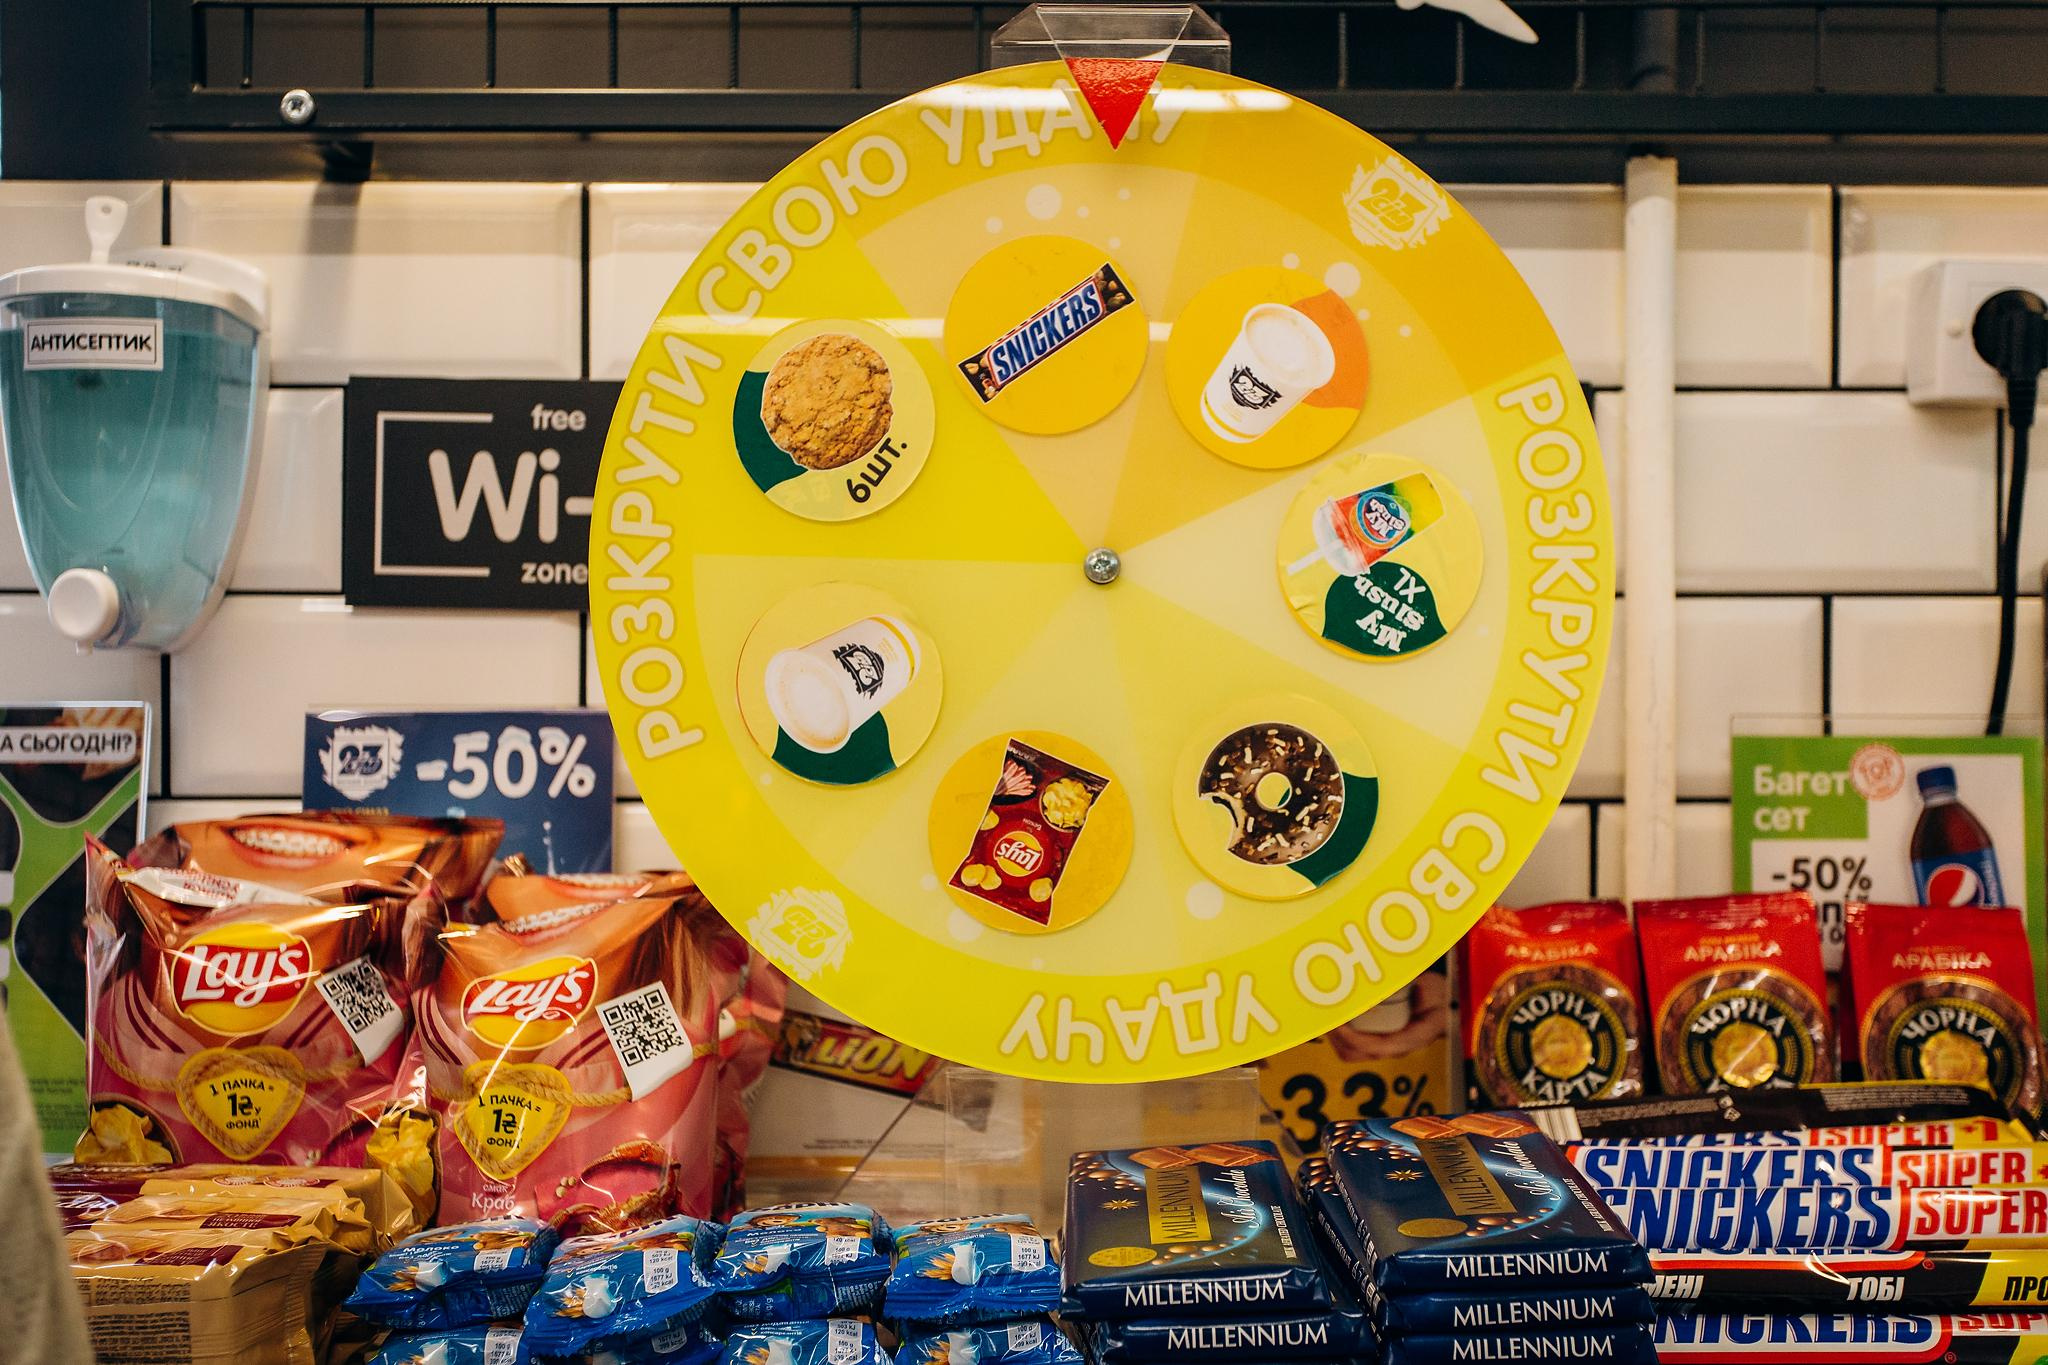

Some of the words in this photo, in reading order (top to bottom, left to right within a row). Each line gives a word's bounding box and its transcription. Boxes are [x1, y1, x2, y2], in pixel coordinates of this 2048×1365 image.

[30, 332, 153, 354] АНТИСЕПТИК
[992, 285, 1102, 383] SNICKERS
[532, 404, 586, 431] free
[608, 334, 722, 759] РОЗКРУТИ
[698, 136, 908, 325] СВОЮ
[920, 80, 1195, 168] УДАУ
[521, 562, 587, 584] zone
[1394, 568, 1426, 604] XL
[1481, 373, 1597, 803] РОЗКРУТИ
[1356, 610, 1407, 653] My
[20, 732, 133, 755] СЬОГОДНІ?
[416, 726, 596, 799] -50%
[1753, 764, 1849, 797] Багет
[1753, 807, 1810, 832] сет
[1772, 857, 1872, 891] -50%
[1293, 812, 1507, 1007] СВОЮ
[182, 943, 303, 1008] Lay's
[467, 967, 591, 1023] Lay's
[1512, 990, 1600, 1032] ЧОРНА
[1001, 972, 1280, 1064] УДАЧУ
[1691, 995, 1788, 1037] ЧОРНА
[1902, 1004, 1998, 1049] ЧОРНА
[222, 1078, 266, 1091] ПАЧКА
[1522, 1066, 1609, 1102] КАРТА
[490, 1094, 532, 1111] ПАЧКА
[1584, 1147, 1877, 1188] SNICKERS
[1897, 1152, 2026, 1187] SUPER
[471, 1192, 516, 1214] Краб
[1156, 1166, 1199, 1240] MILLENNIUM
[1597, 1187, 1893, 1249] SNICKERS
[1913, 1189, 2048, 1235] SUPER
[1446, 1251, 1609, 1279] MILLENNIUM
[1125, 1278, 1285, 1308] MILLENNIUM
[1846, 1275, 1905, 1302] ТОБІ
[1453, 1295, 1615, 1328] MILLENNIUM
[1650, 1314, 1934, 1344] NICKERS
[1957, 1313, 2048, 1332] SUP
[1167, 1322, 1329, 1351] MILLENNIUM
[1452, 1334, 1614, 1362] MILLENNIUM
